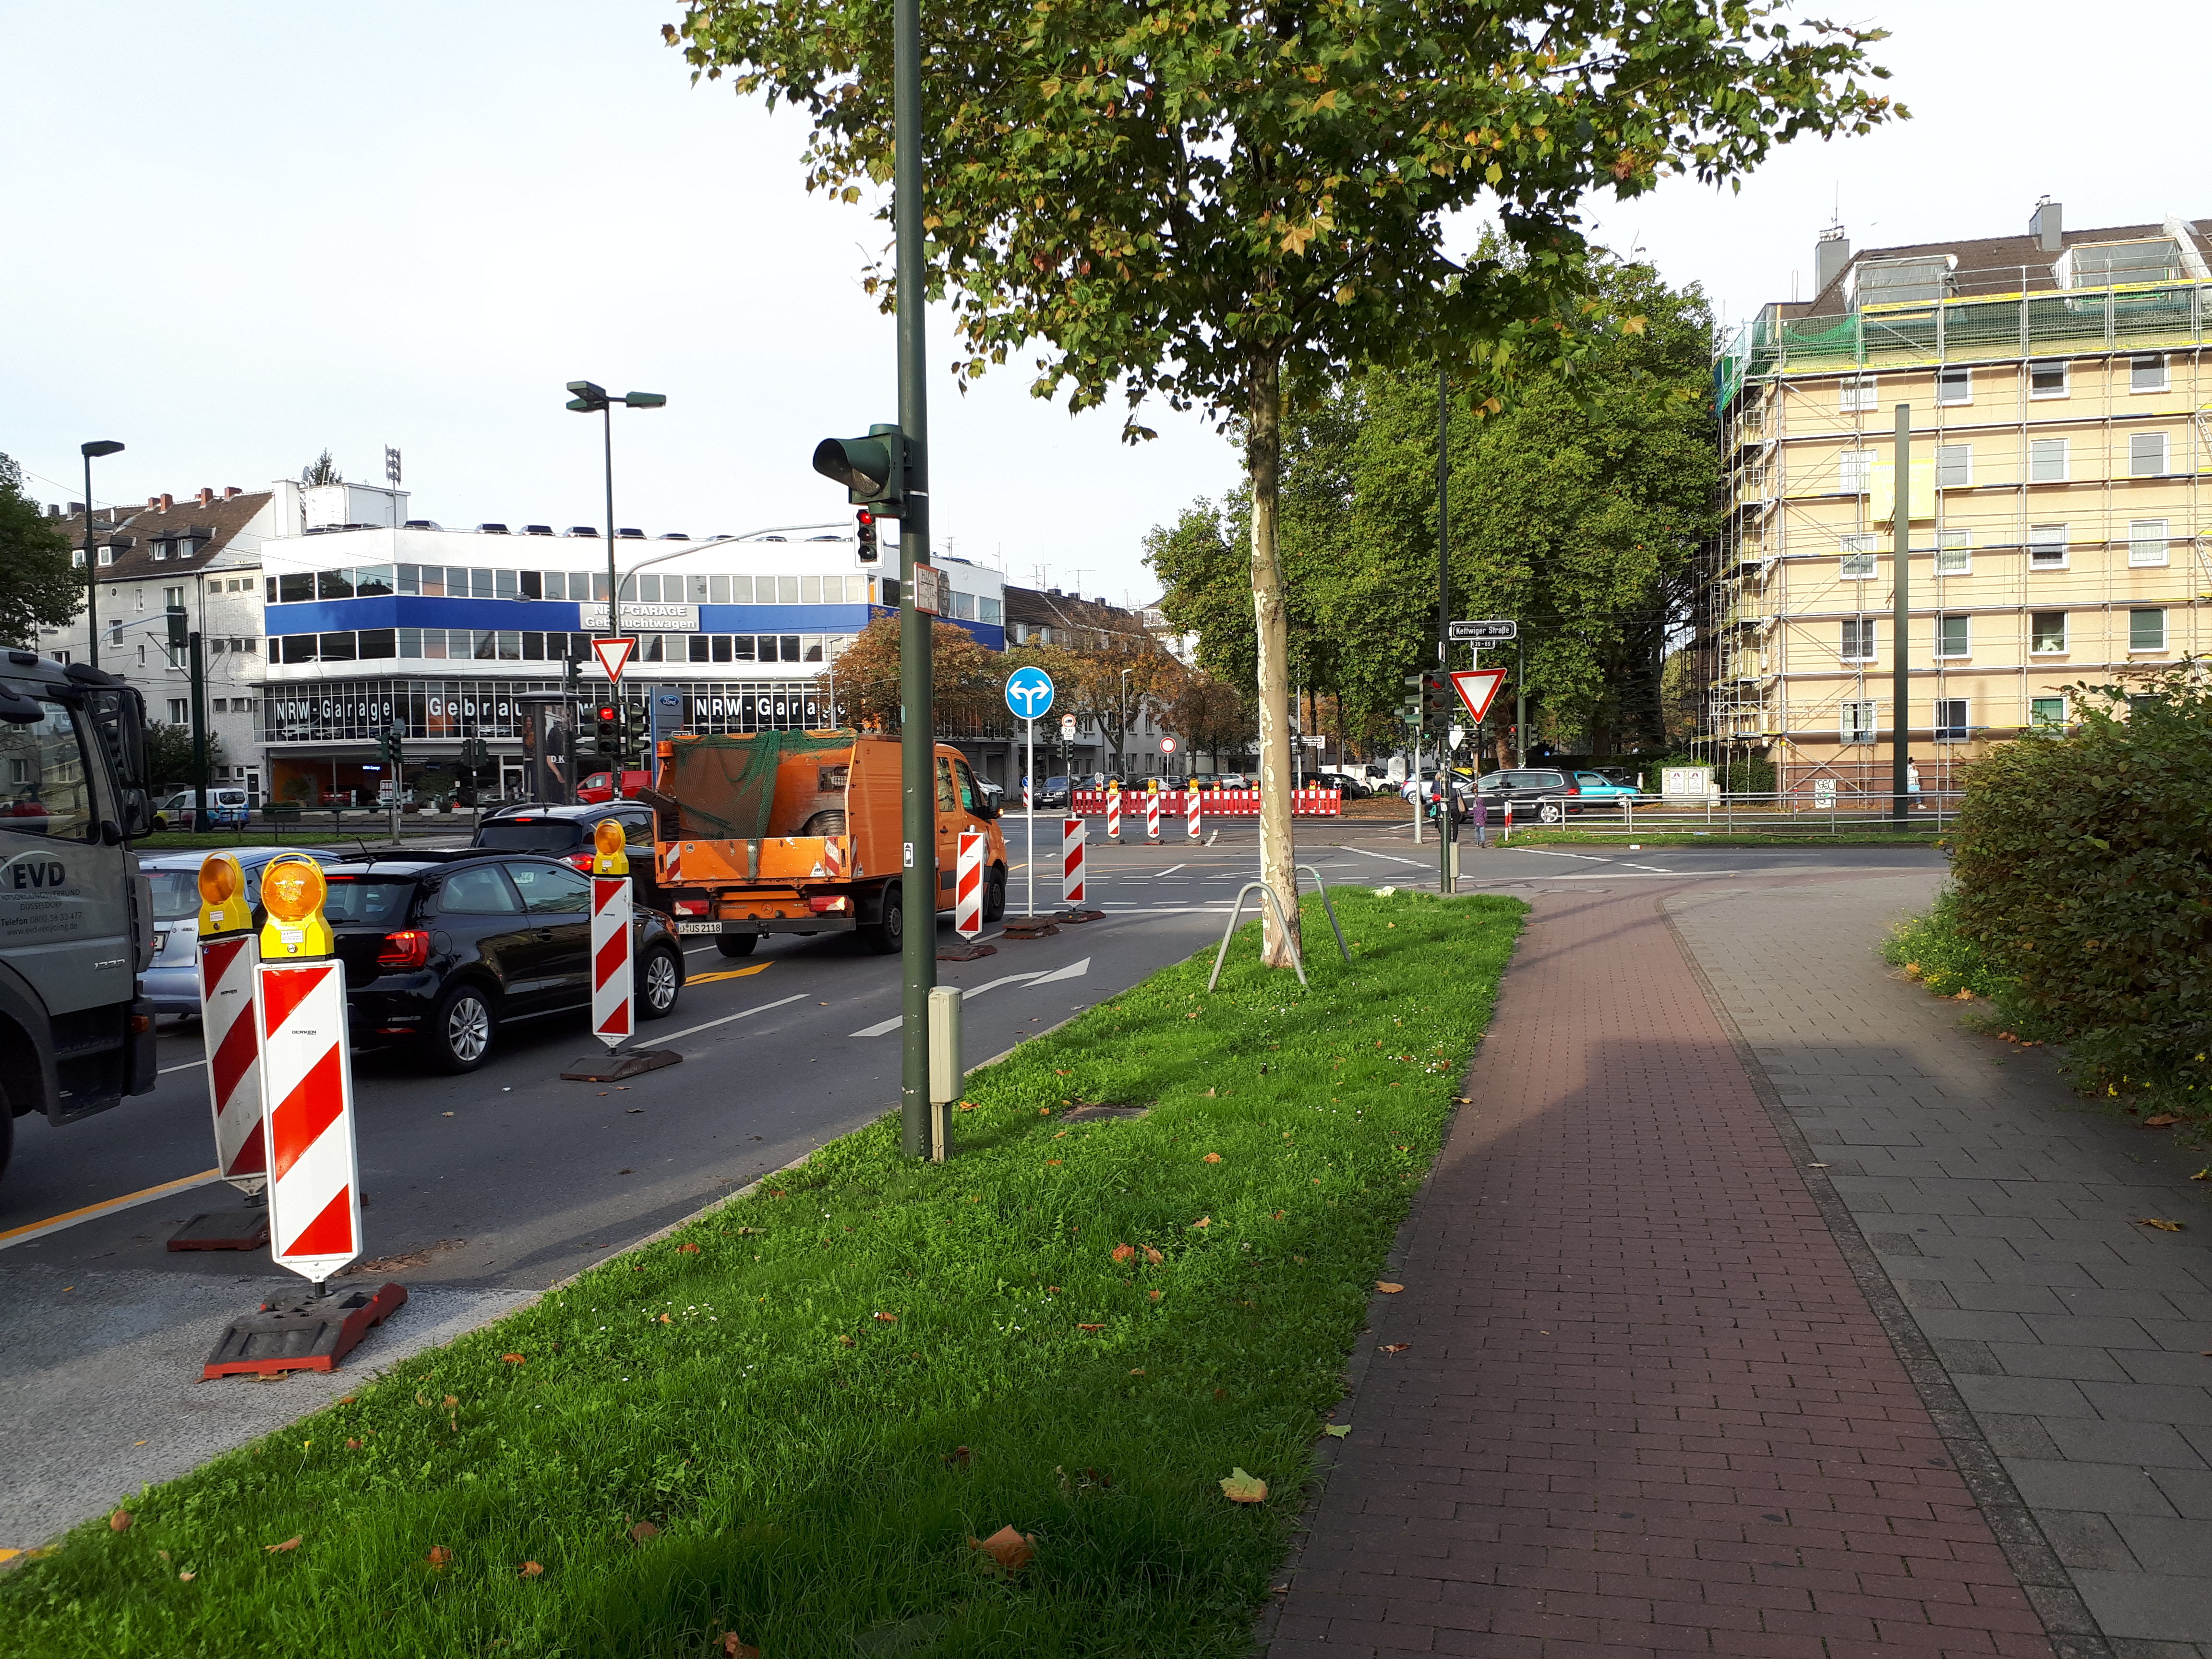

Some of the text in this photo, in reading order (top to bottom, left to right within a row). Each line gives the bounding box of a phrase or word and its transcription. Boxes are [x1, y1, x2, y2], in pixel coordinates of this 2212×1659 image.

[585, 617, 695, 630] Gebauchtwagen
[1456, 626, 1510, 636] Kettwiger Straße
[662, 696, 677, 705] Ford
[276, 700, 391, 721] NRW-Garage
[13, 862, 65, 890] EVD
[0, 889, 81, 901] NTSORGUNGSVERBUND
[0, 917, 28, 926] Telefon
[701, 924, 721, 932] 2118
